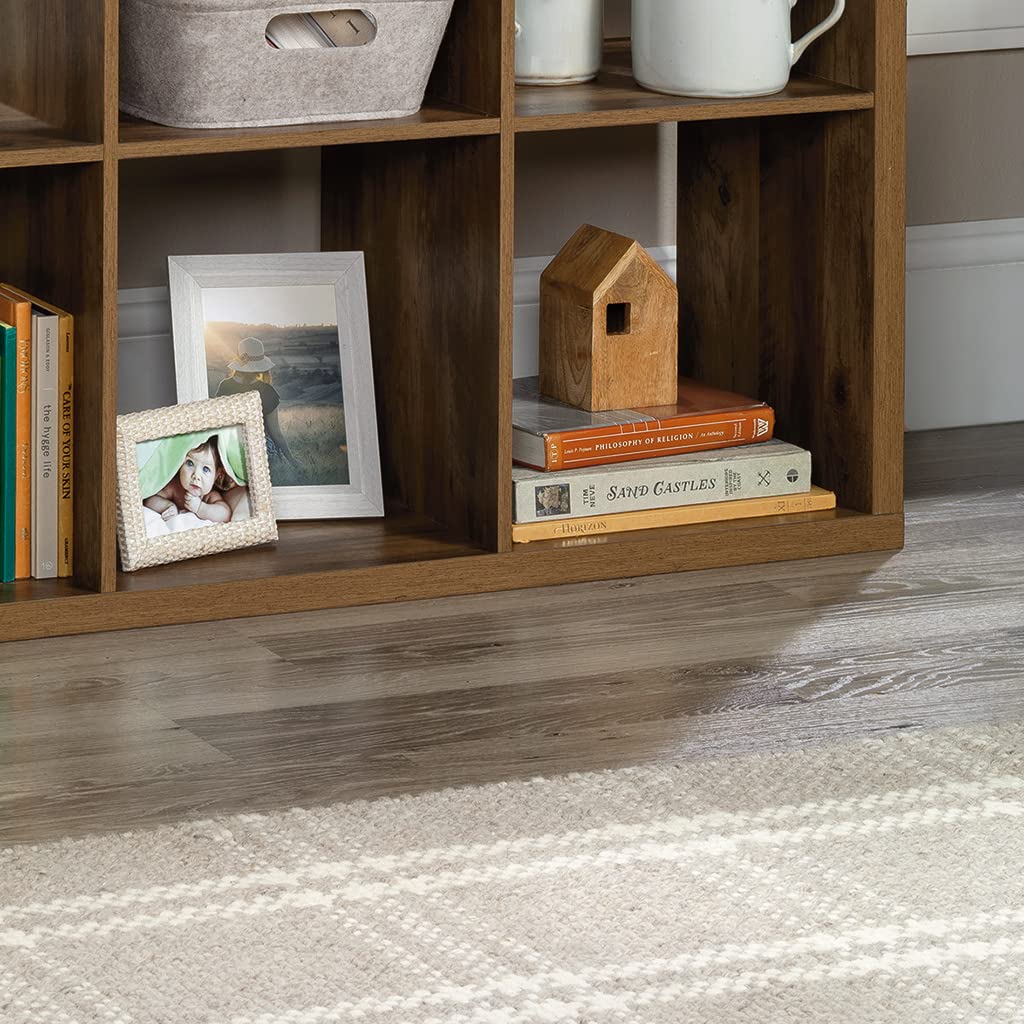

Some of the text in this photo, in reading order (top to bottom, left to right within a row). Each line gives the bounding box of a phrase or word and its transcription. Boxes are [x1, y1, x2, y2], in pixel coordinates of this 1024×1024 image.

[62, 391, 71, 420] CARE
[41, 405, 52, 479] the hygge life
[62, 422, 71, 437] OF
[595, 439, 642, 451] PHILOSOPHY
[644, 437, 655, 445] OF
[656, 432, 694, 444] RELIGION
[62, 439, 71, 471] YOUR
[62, 472, 71, 500] SKIN
[606, 478, 717, 502] SAND CASTLES
